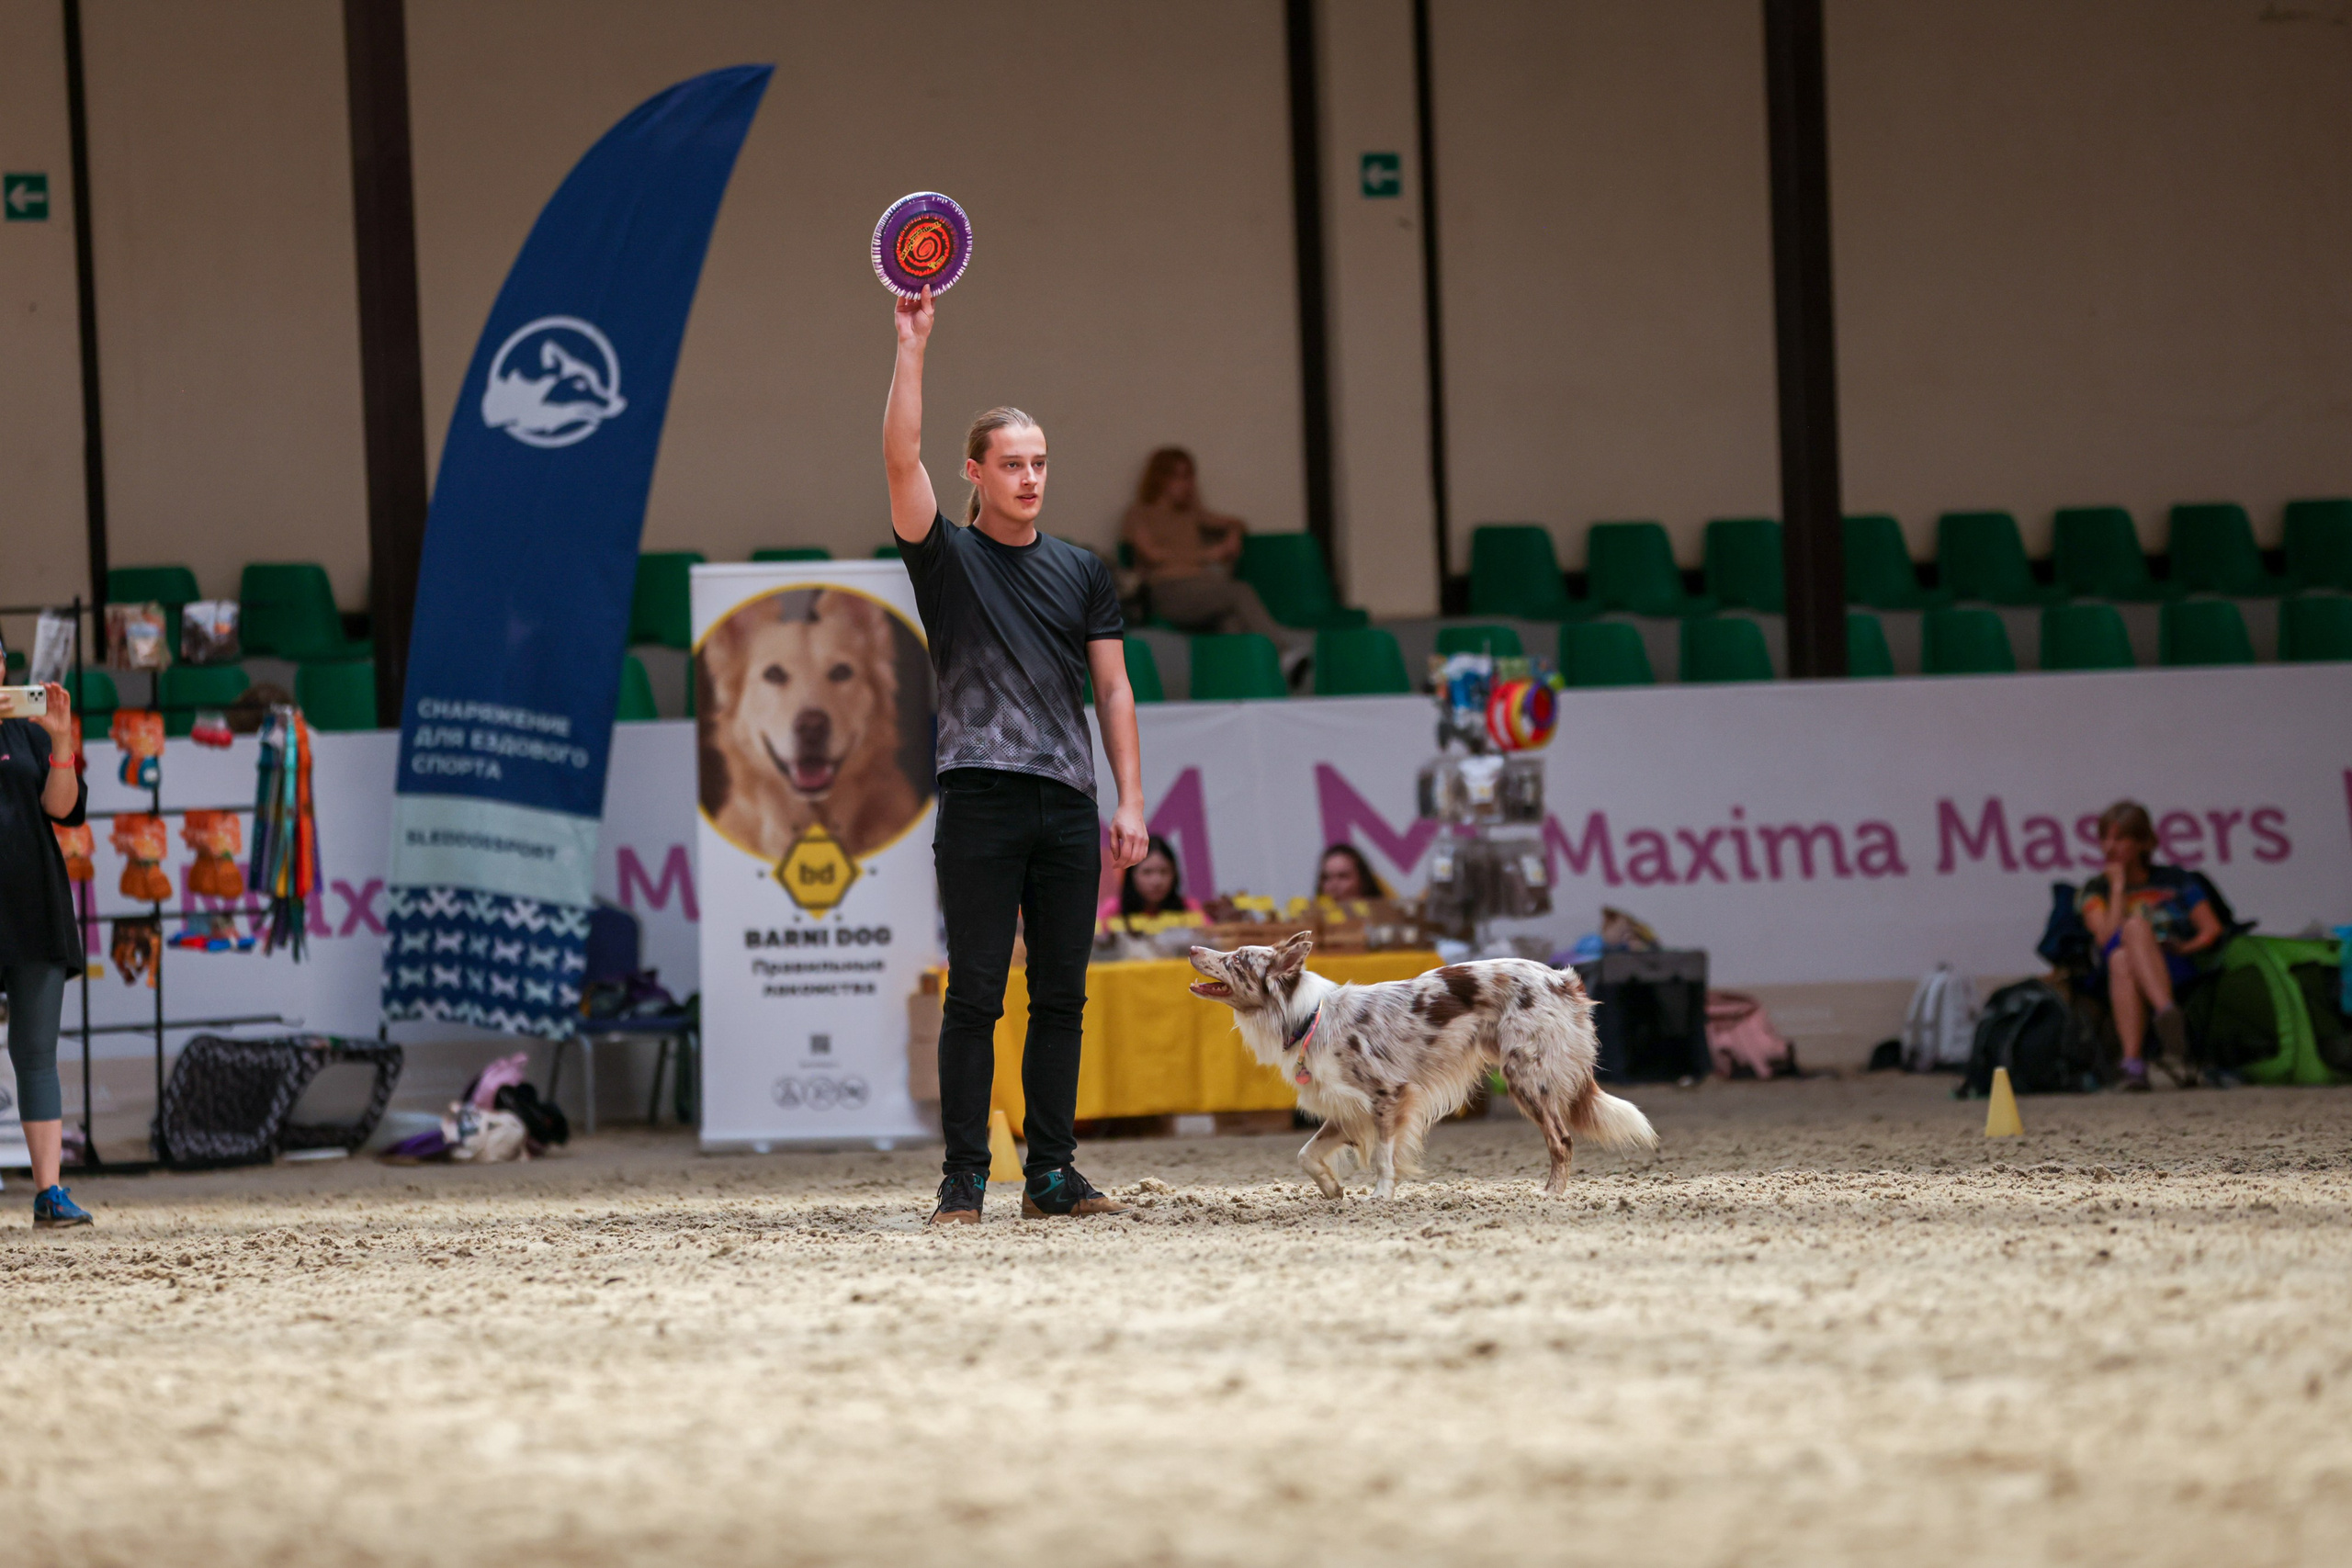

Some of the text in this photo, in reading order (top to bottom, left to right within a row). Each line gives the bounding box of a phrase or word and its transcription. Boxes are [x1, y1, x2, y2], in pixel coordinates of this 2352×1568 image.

[417, 697, 571, 738] СНАРЯЖЕНИЕ
[412, 752, 503, 780] СПОРТА
[413, 725, 589, 769] ДЛЯ ЕЗДОВОГО
[1543, 805, 1909, 887] Maxima
[1937, 795, 2292, 874] Masers
[745, 926, 891, 949] BARNI DOG
